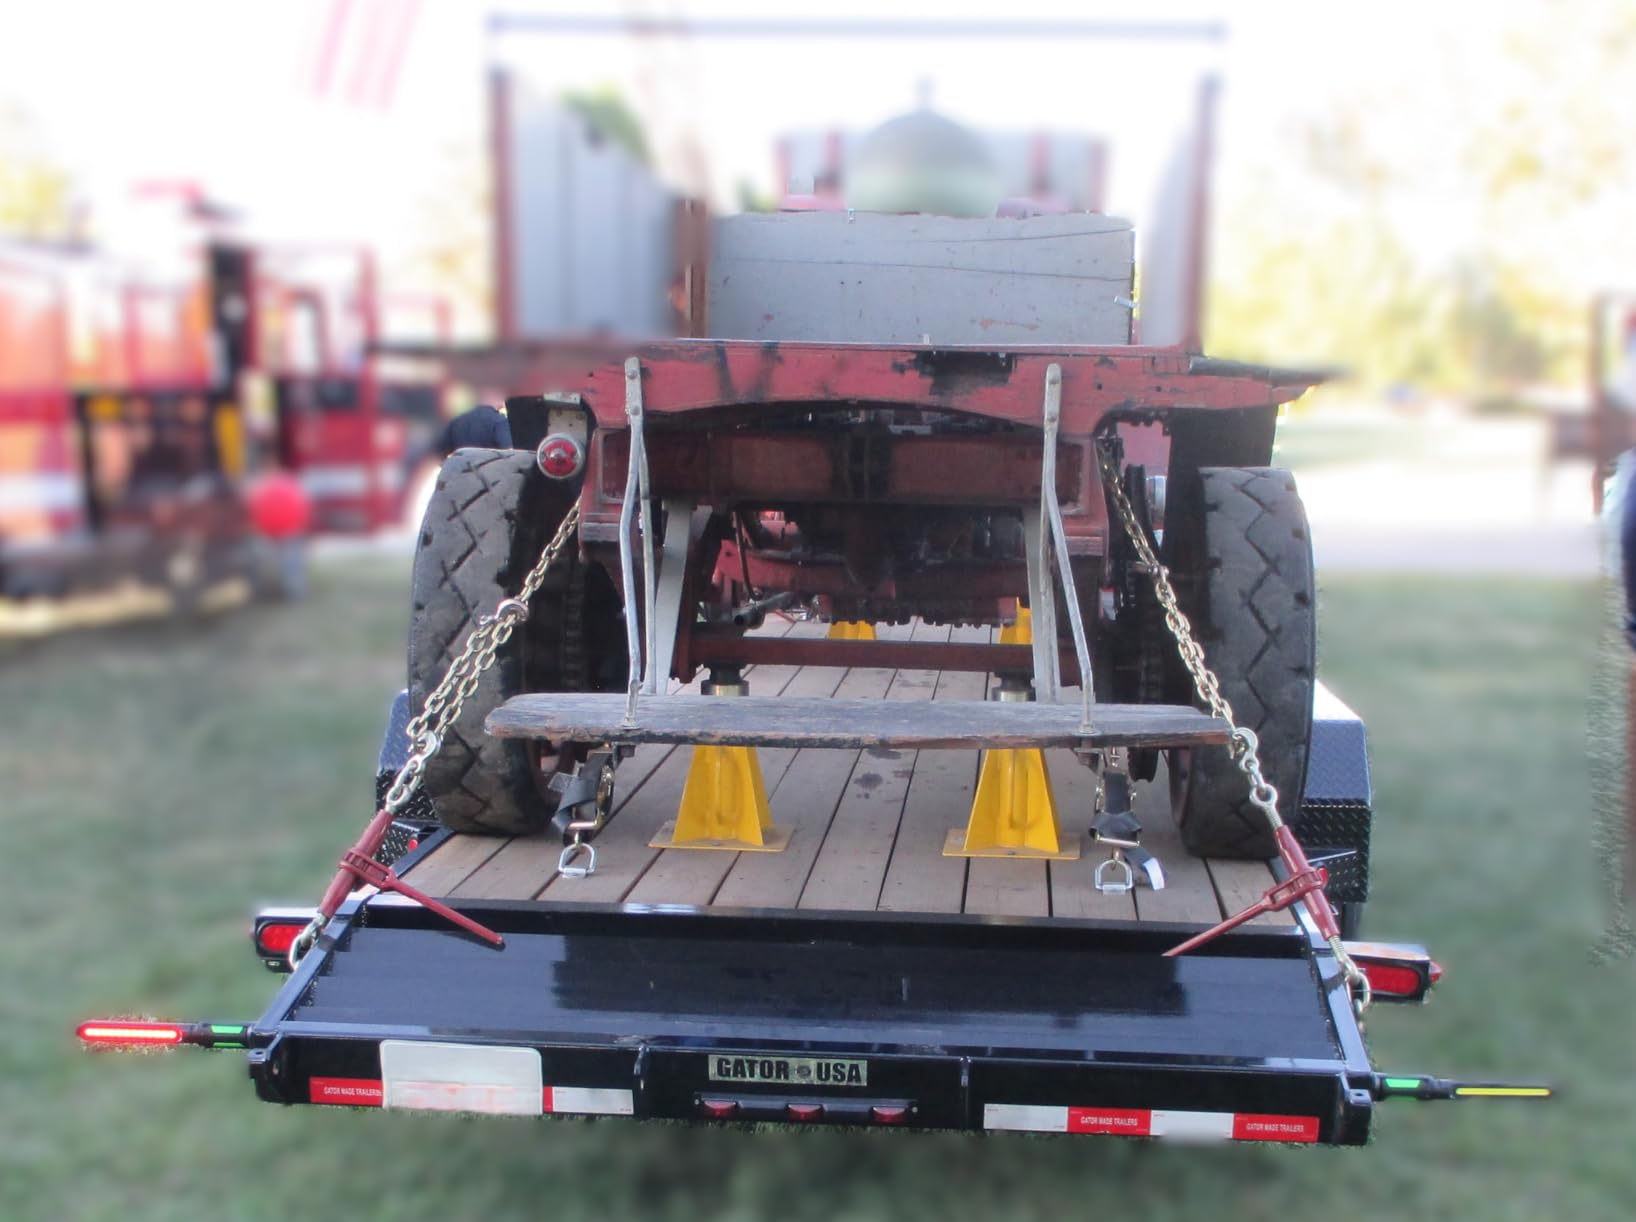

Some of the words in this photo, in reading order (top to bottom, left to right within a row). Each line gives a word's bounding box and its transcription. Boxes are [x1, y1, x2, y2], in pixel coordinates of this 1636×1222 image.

[717, 1057, 789, 1081] GATOR
[816, 1061, 861, 1083] USA
[324, 1086, 340, 1095] GATOR
[341, 1087, 355, 1096] MADE
[1081, 1116, 1097, 1125] GATOR
[1099, 1117, 1113, 1126] MADE
[1114, 1117, 1137, 1126] TRAILERS
[1247, 1123, 1263, 1131] GATOR
[1265, 1124, 1279, 1132] MADE
[1280, 1124, 1304, 1133] TRAILERS
